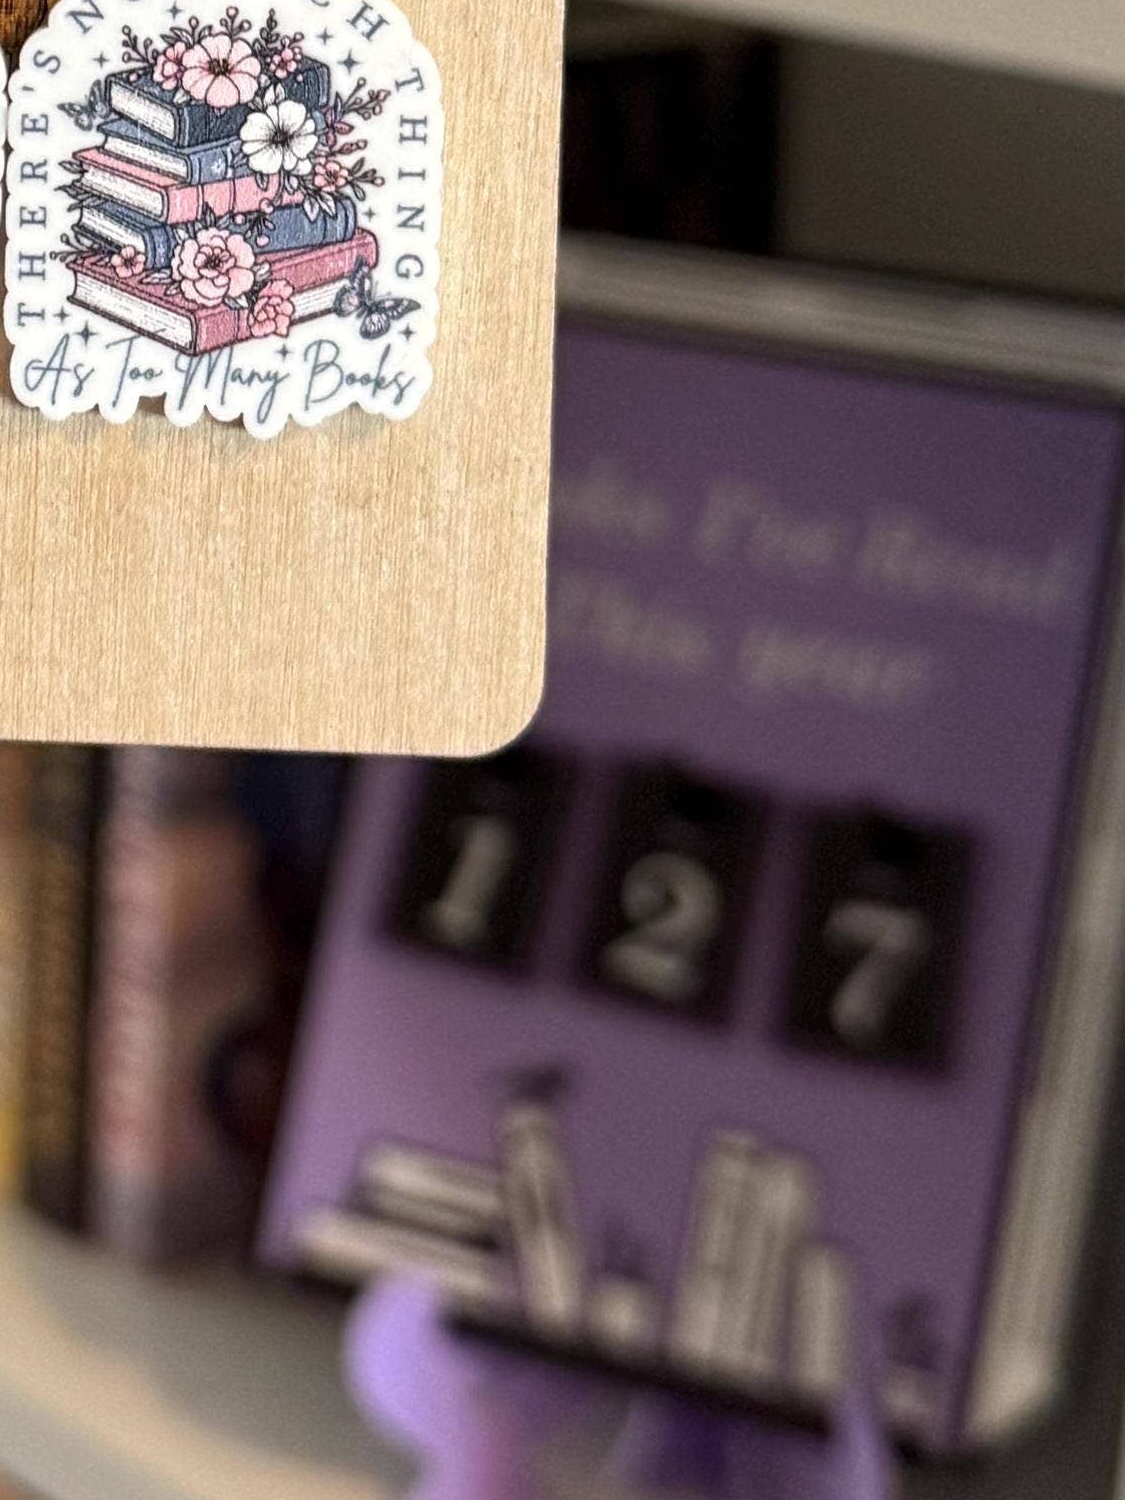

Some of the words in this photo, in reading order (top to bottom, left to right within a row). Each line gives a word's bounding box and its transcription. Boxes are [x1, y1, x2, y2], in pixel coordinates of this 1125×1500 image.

[394, 68, 429, 279] THING
[24, 332, 94, 406] As
[104, 336, 163, 408] Too
[173, 345, 291, 426] Many
[302, 339, 416, 405] Books
